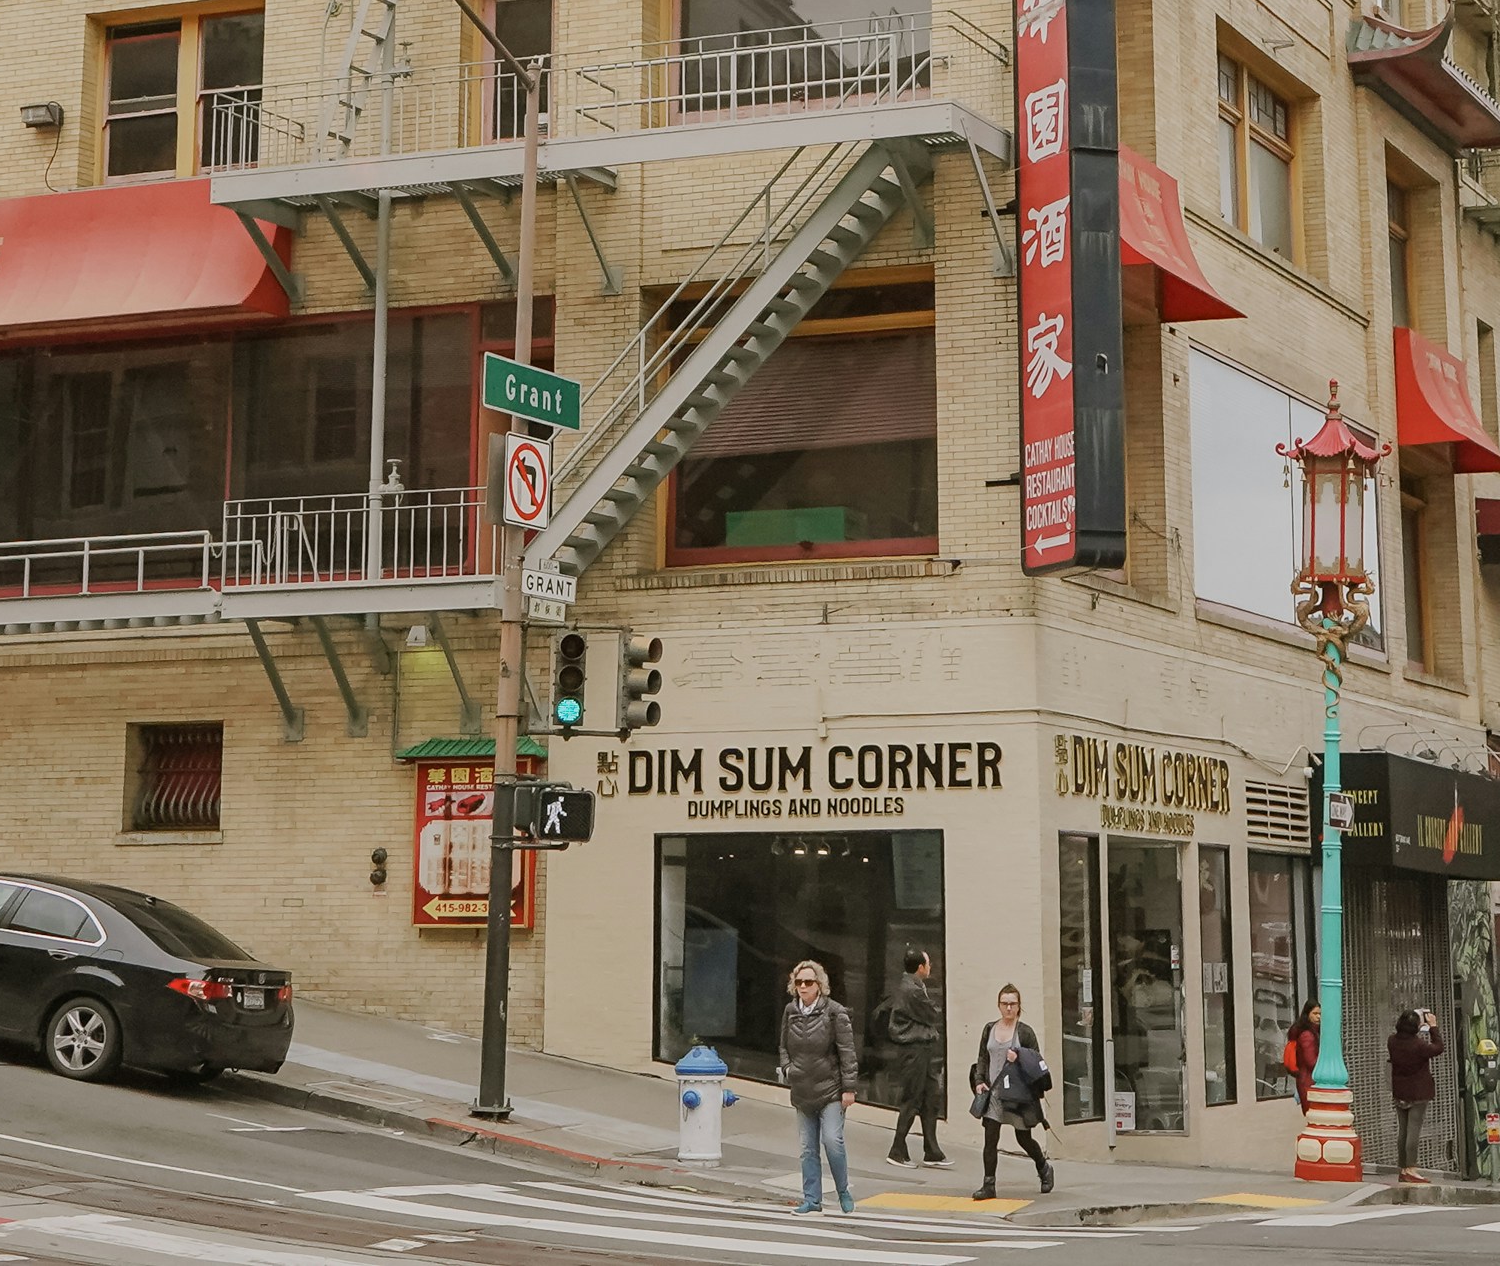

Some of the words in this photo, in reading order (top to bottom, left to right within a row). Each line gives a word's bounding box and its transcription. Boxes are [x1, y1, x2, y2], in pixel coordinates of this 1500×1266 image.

[505, 373, 562, 415] Grant
[1025, 437, 1053, 468] CATHAY
[1055, 431, 1075, 460] HOUSE
[1026, 462, 1075, 499] RESTAURANT
[1026, 502, 1068, 531] COCKTAILS
[525, 573, 573, 598] GRANT
[427, 767, 494, 784] 華園酒
[628, 747, 704, 795] DIM
[718, 745, 813, 793] SUM
[827, 741, 1003, 790] CORNER
[1070, 734, 1109, 800] DIM
[1113, 742, 1157, 805] SUM
[1160, 750, 1231, 815] CORNER
[688, 798, 782, 819] DUMPLINGS
[788, 797, 821, 817] AND
[827, 796, 905, 817] NOODLES
[435, 902, 488, 914] 415-982-3
